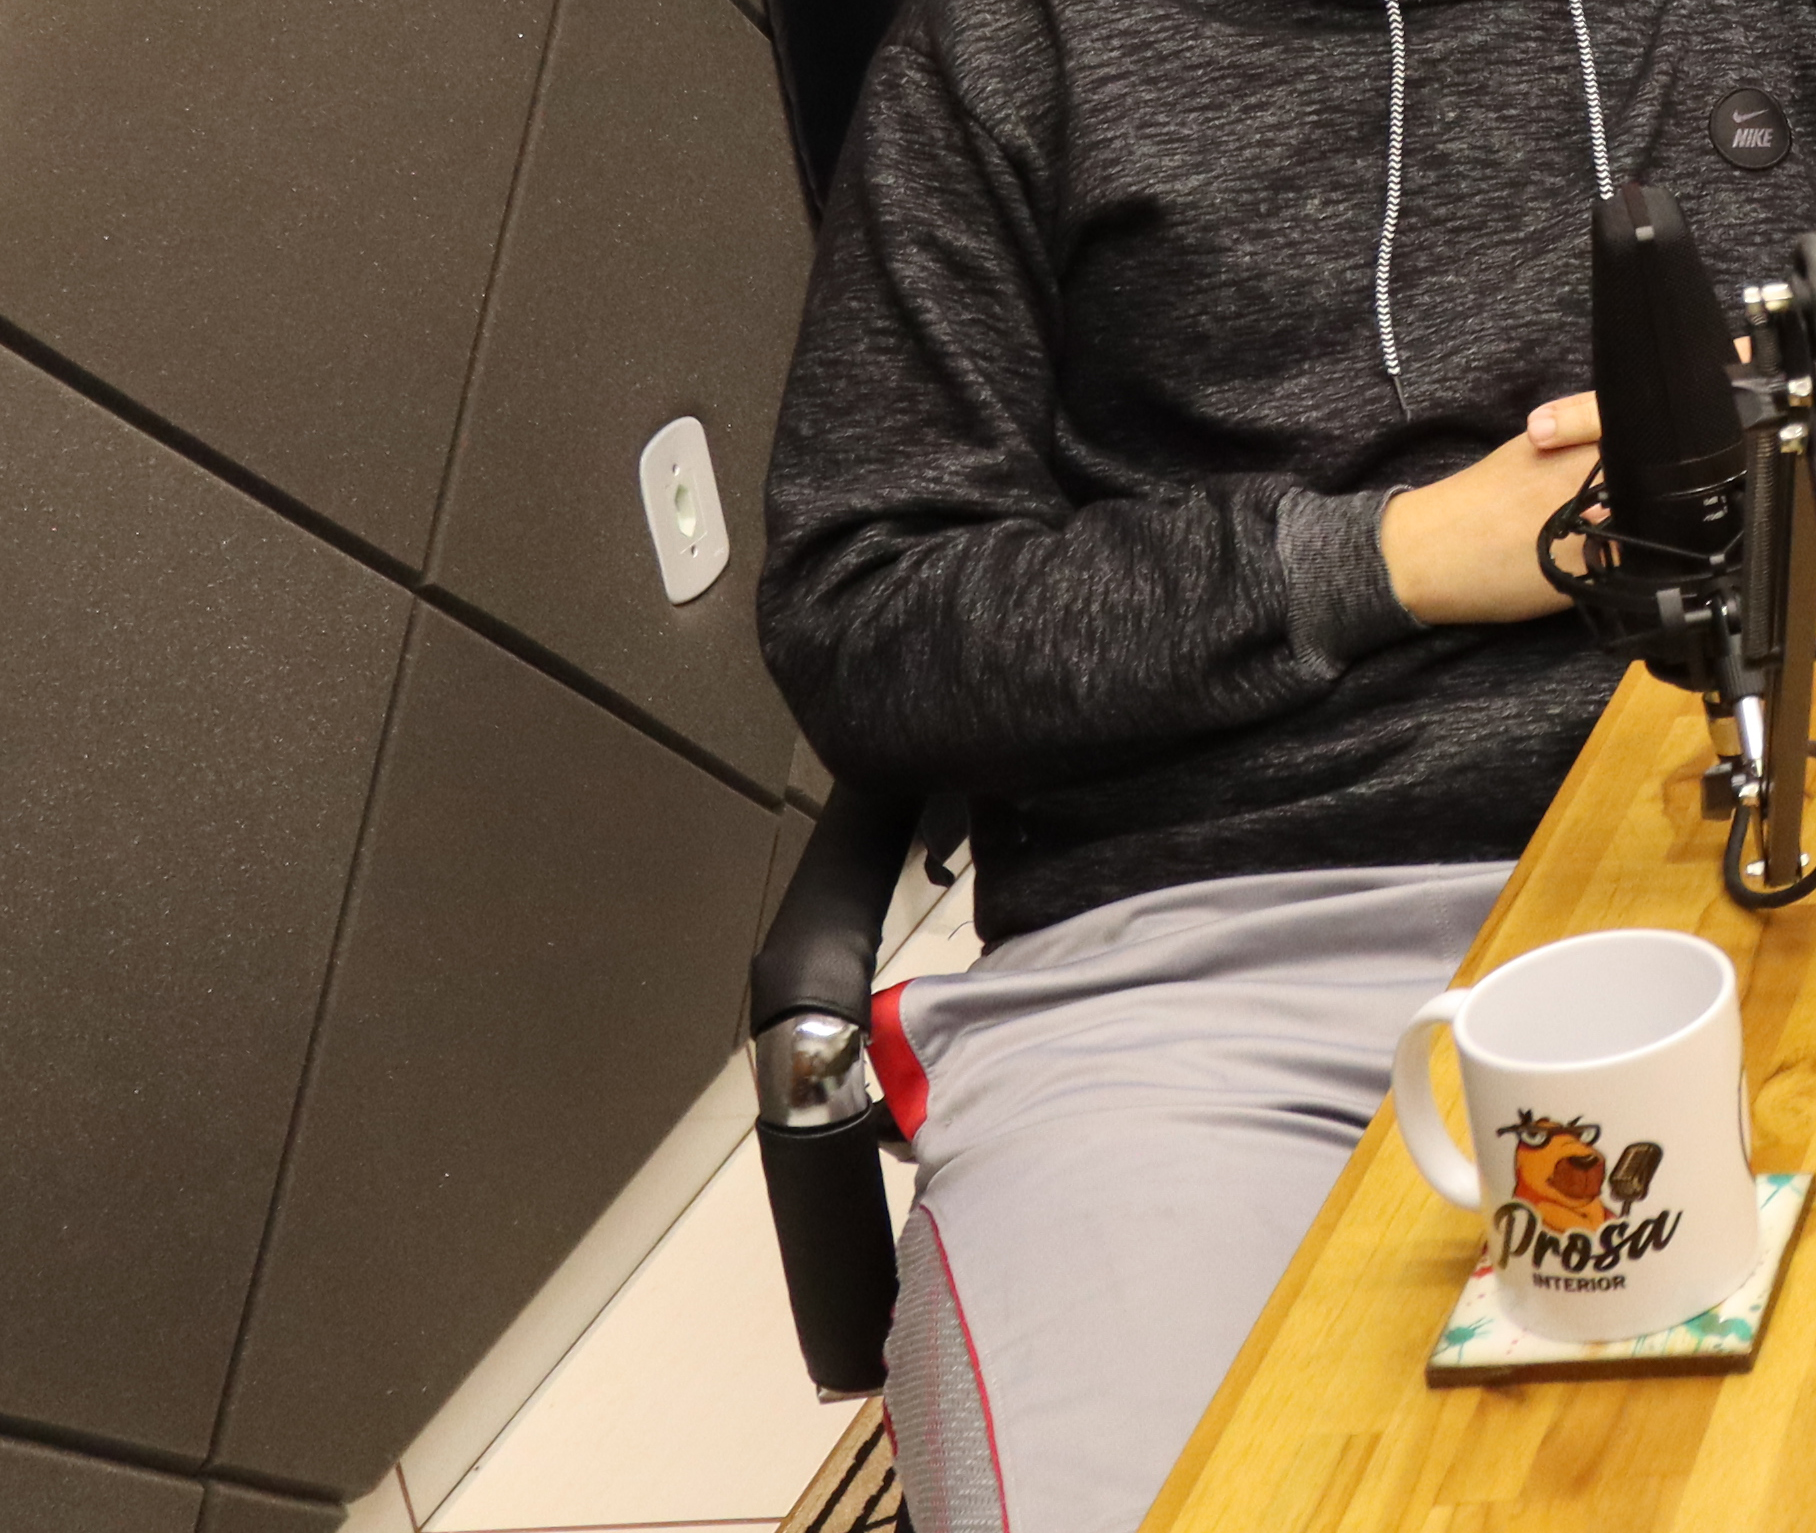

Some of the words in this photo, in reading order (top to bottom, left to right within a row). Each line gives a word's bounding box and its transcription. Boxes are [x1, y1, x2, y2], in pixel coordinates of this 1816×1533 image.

[1732, 128, 1773, 148] NIKE
[1494, 1203, 1682, 1271] Prosa
[1532, 1273, 1625, 1292] INTERIOR
